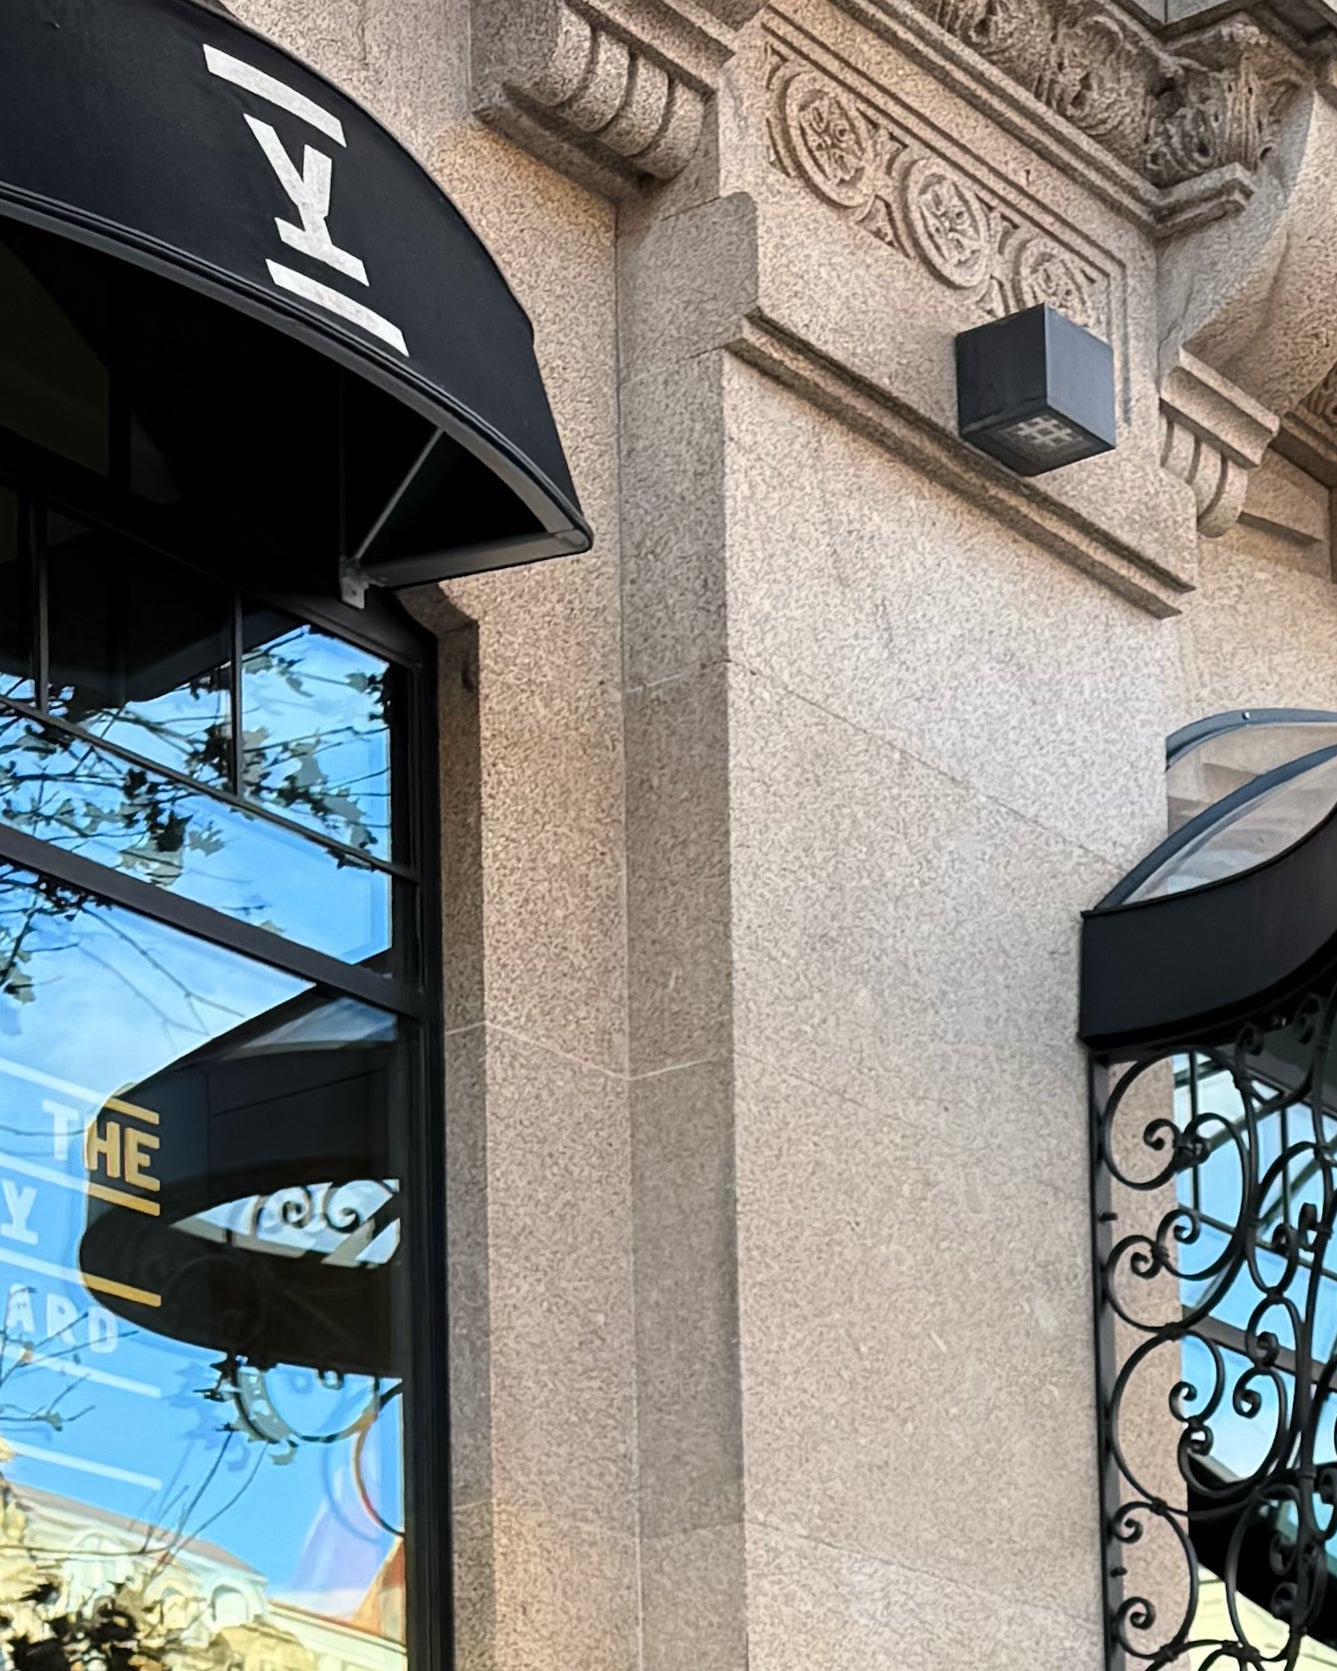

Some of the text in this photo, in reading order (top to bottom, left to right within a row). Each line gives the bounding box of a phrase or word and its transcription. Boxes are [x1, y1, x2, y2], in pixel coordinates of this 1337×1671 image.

[243, 113, 370, 286] Y
[42, 1100, 160, 1192] THE
[0, 1179, 39, 1245] Y
